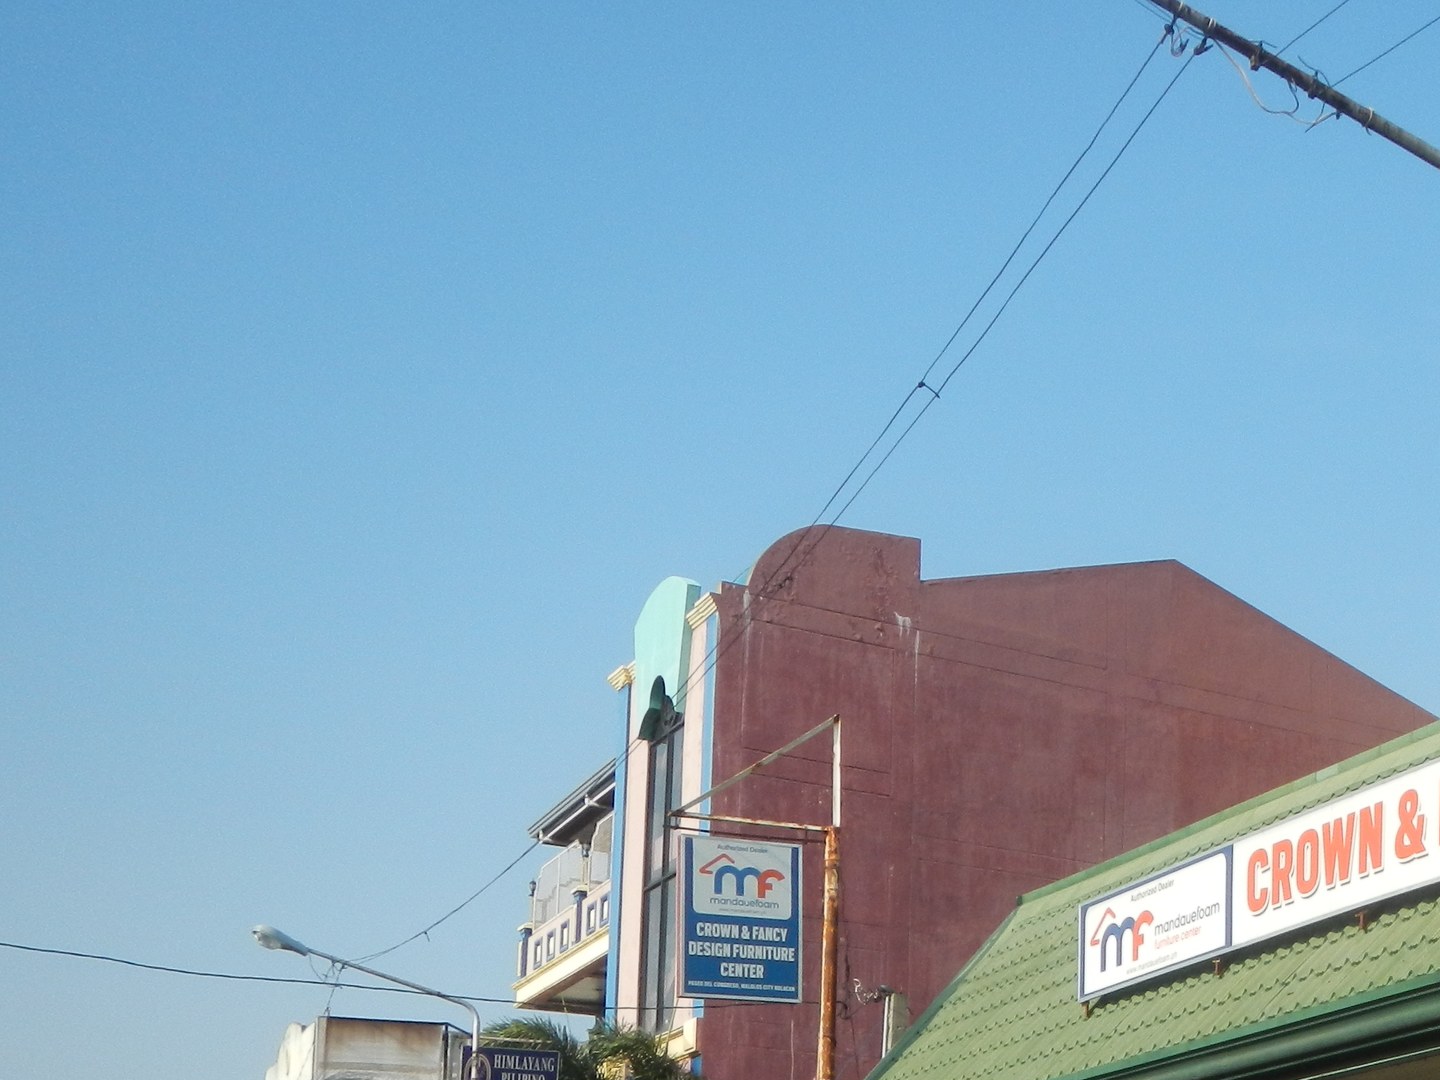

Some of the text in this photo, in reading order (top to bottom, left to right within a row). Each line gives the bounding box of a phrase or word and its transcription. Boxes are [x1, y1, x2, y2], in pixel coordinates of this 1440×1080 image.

[1246, 801, 1386, 917] CROWN
[1395, 788, 1428, 862] &
[1130, 879, 1175, 902] Authorized Dealer
[709, 897, 780, 909] mandauefoam
[1154, 902, 1221, 937] mandauefoam
[696, 922, 788, 942] CROWN & FANCY
[1180, 925, 1203, 941] center
[688, 940, 795, 962] DESIGN FURNITURE
[720, 962, 765, 979] CENTER
[493, 1054, 555, 1072] HIMLAYANG
